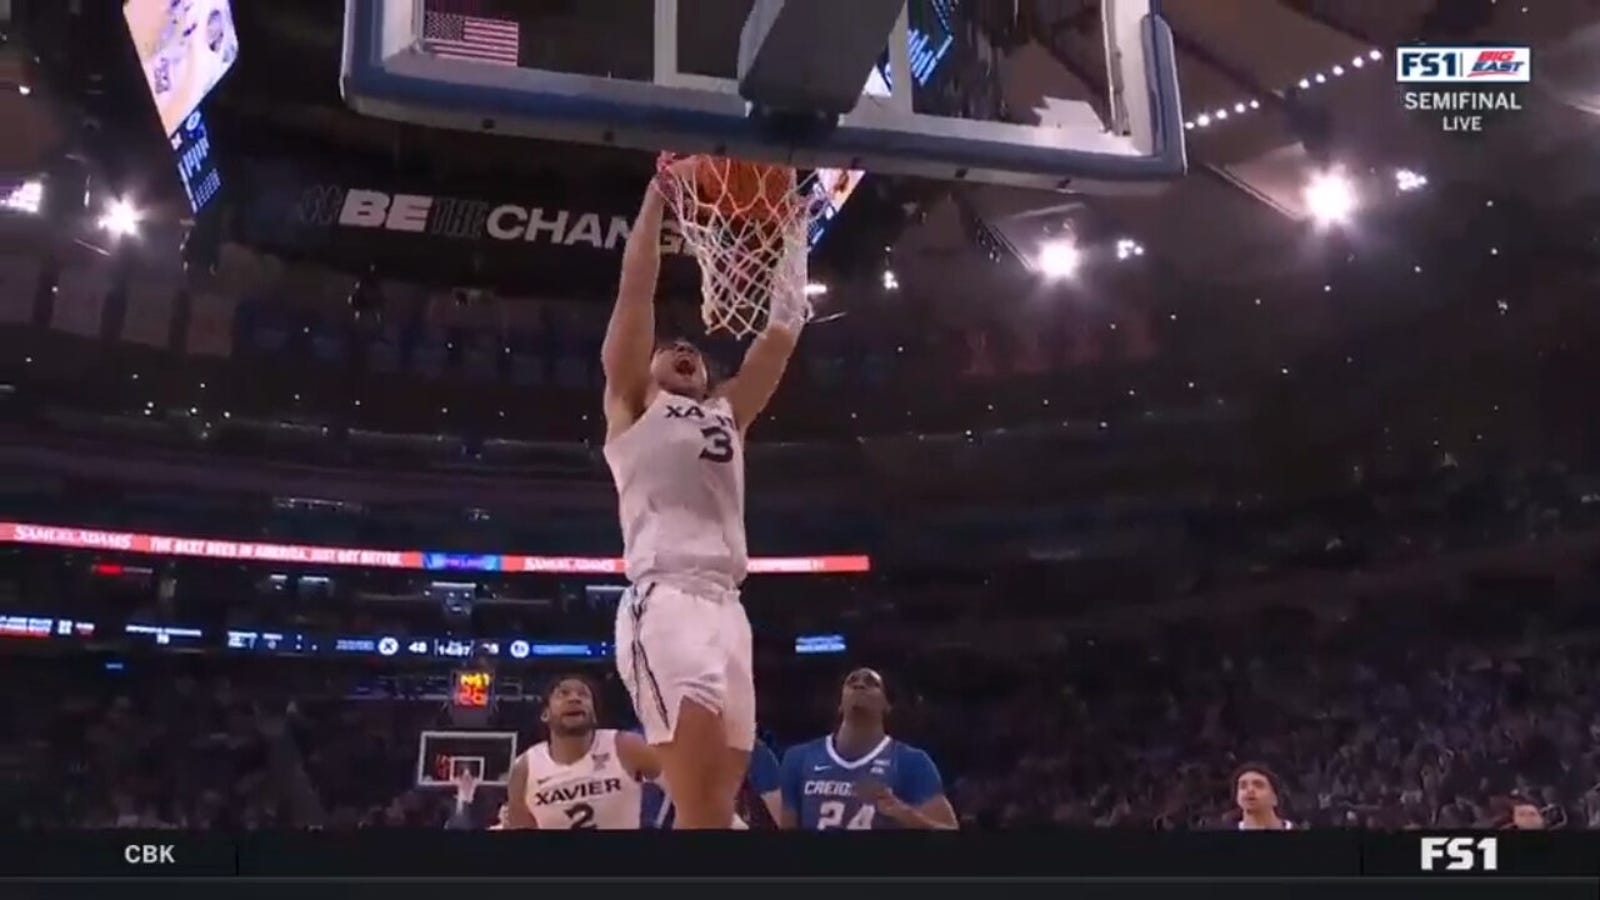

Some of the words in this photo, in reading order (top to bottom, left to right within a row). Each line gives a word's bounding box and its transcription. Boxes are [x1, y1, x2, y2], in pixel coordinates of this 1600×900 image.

[699, 426, 734, 464] 3
[78, 530, 132, 549] ADAMS
[535, 777, 621, 806] XAVIER
[564, 802, 598, 829] 2
[817, 801, 876, 829] 24
